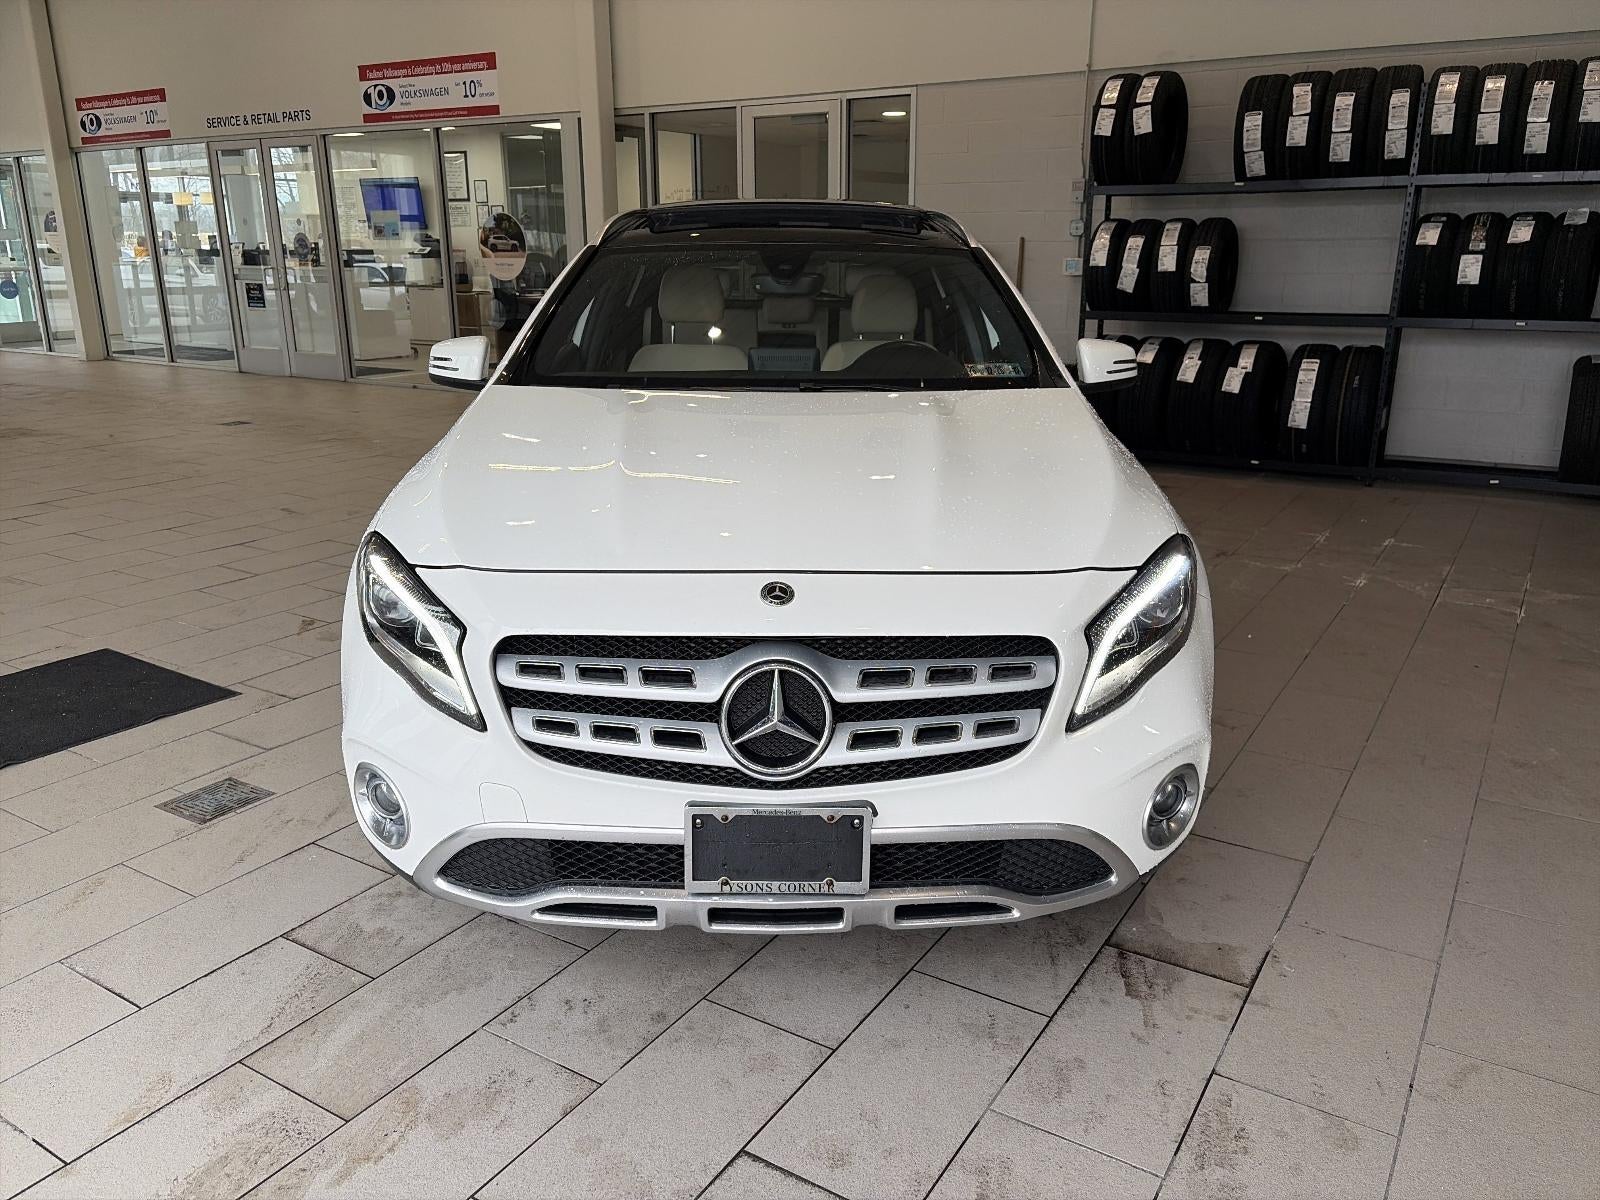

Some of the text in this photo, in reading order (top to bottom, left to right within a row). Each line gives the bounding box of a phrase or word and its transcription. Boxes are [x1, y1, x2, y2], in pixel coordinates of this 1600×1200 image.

[384, 67, 407, 79] Volkswagen
[412, 64, 436, 76] Celebrating
[452, 63, 461, 73] year
[368, 85, 388, 109] 10
[400, 87, 449, 99] VOLKSWAGEN
[103, 115, 137, 126] VOLKSWAGEN
[206, 109, 311, 129] SERVICE & RETAIL PARTS
[778, 882, 835, 893] CORNER
